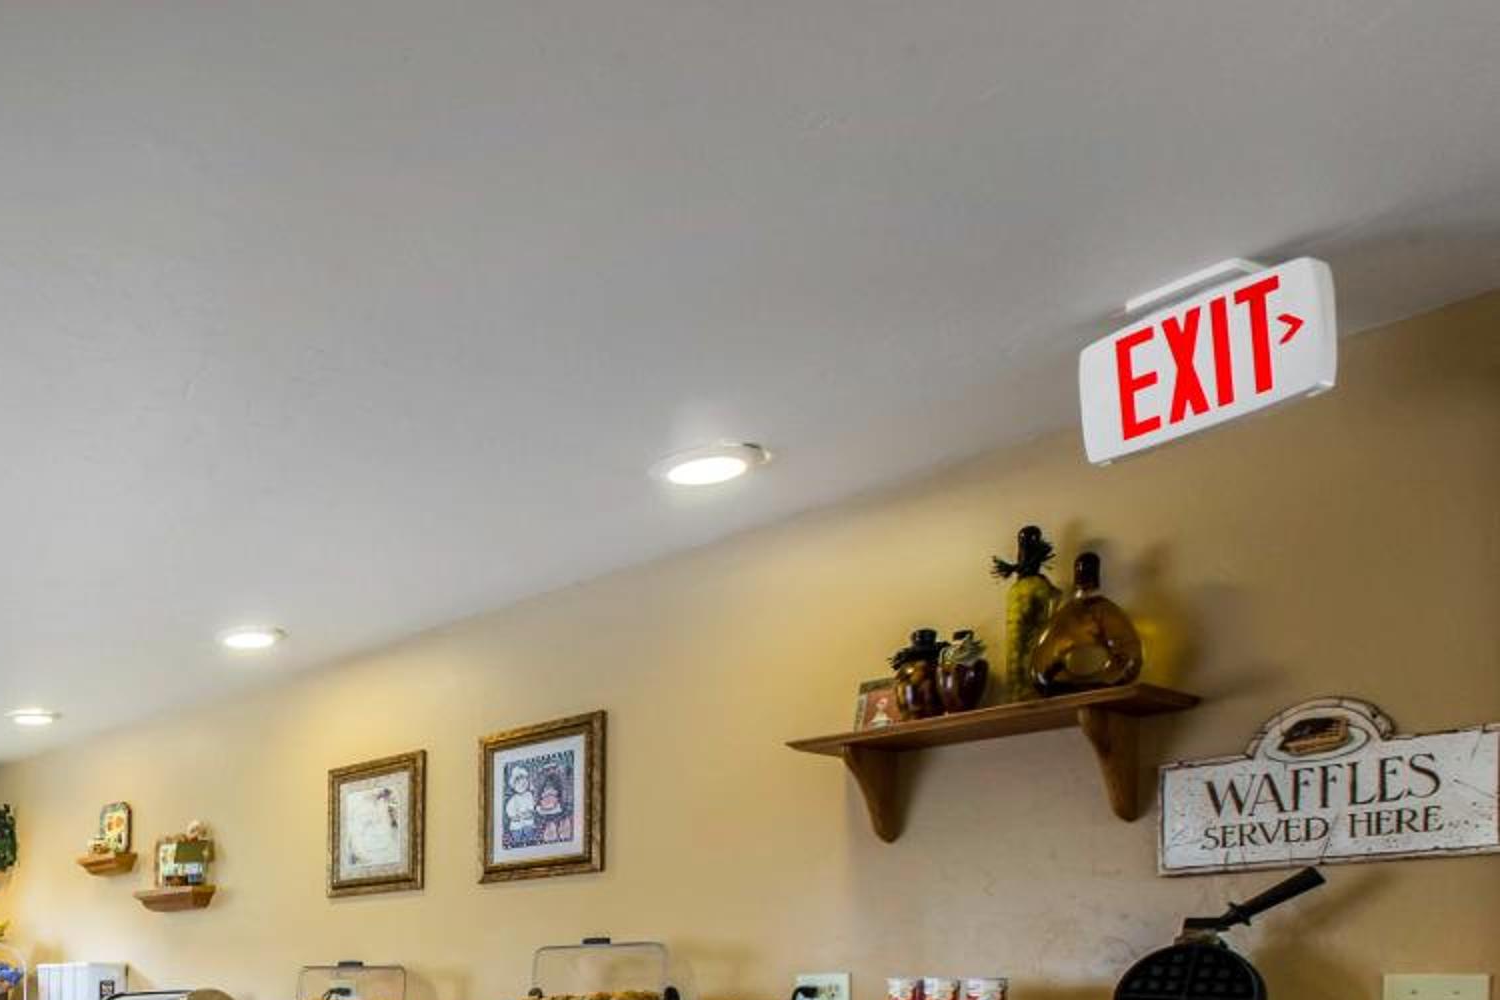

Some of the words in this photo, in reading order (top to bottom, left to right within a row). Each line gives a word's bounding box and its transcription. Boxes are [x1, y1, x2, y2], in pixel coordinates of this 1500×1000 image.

[1115, 274, 1280, 441] EXIT
[1204, 753, 1442, 818] WAFFLES
[1202, 816, 1330, 850] SERVED
[1349, 805, 1444, 838] HERE
